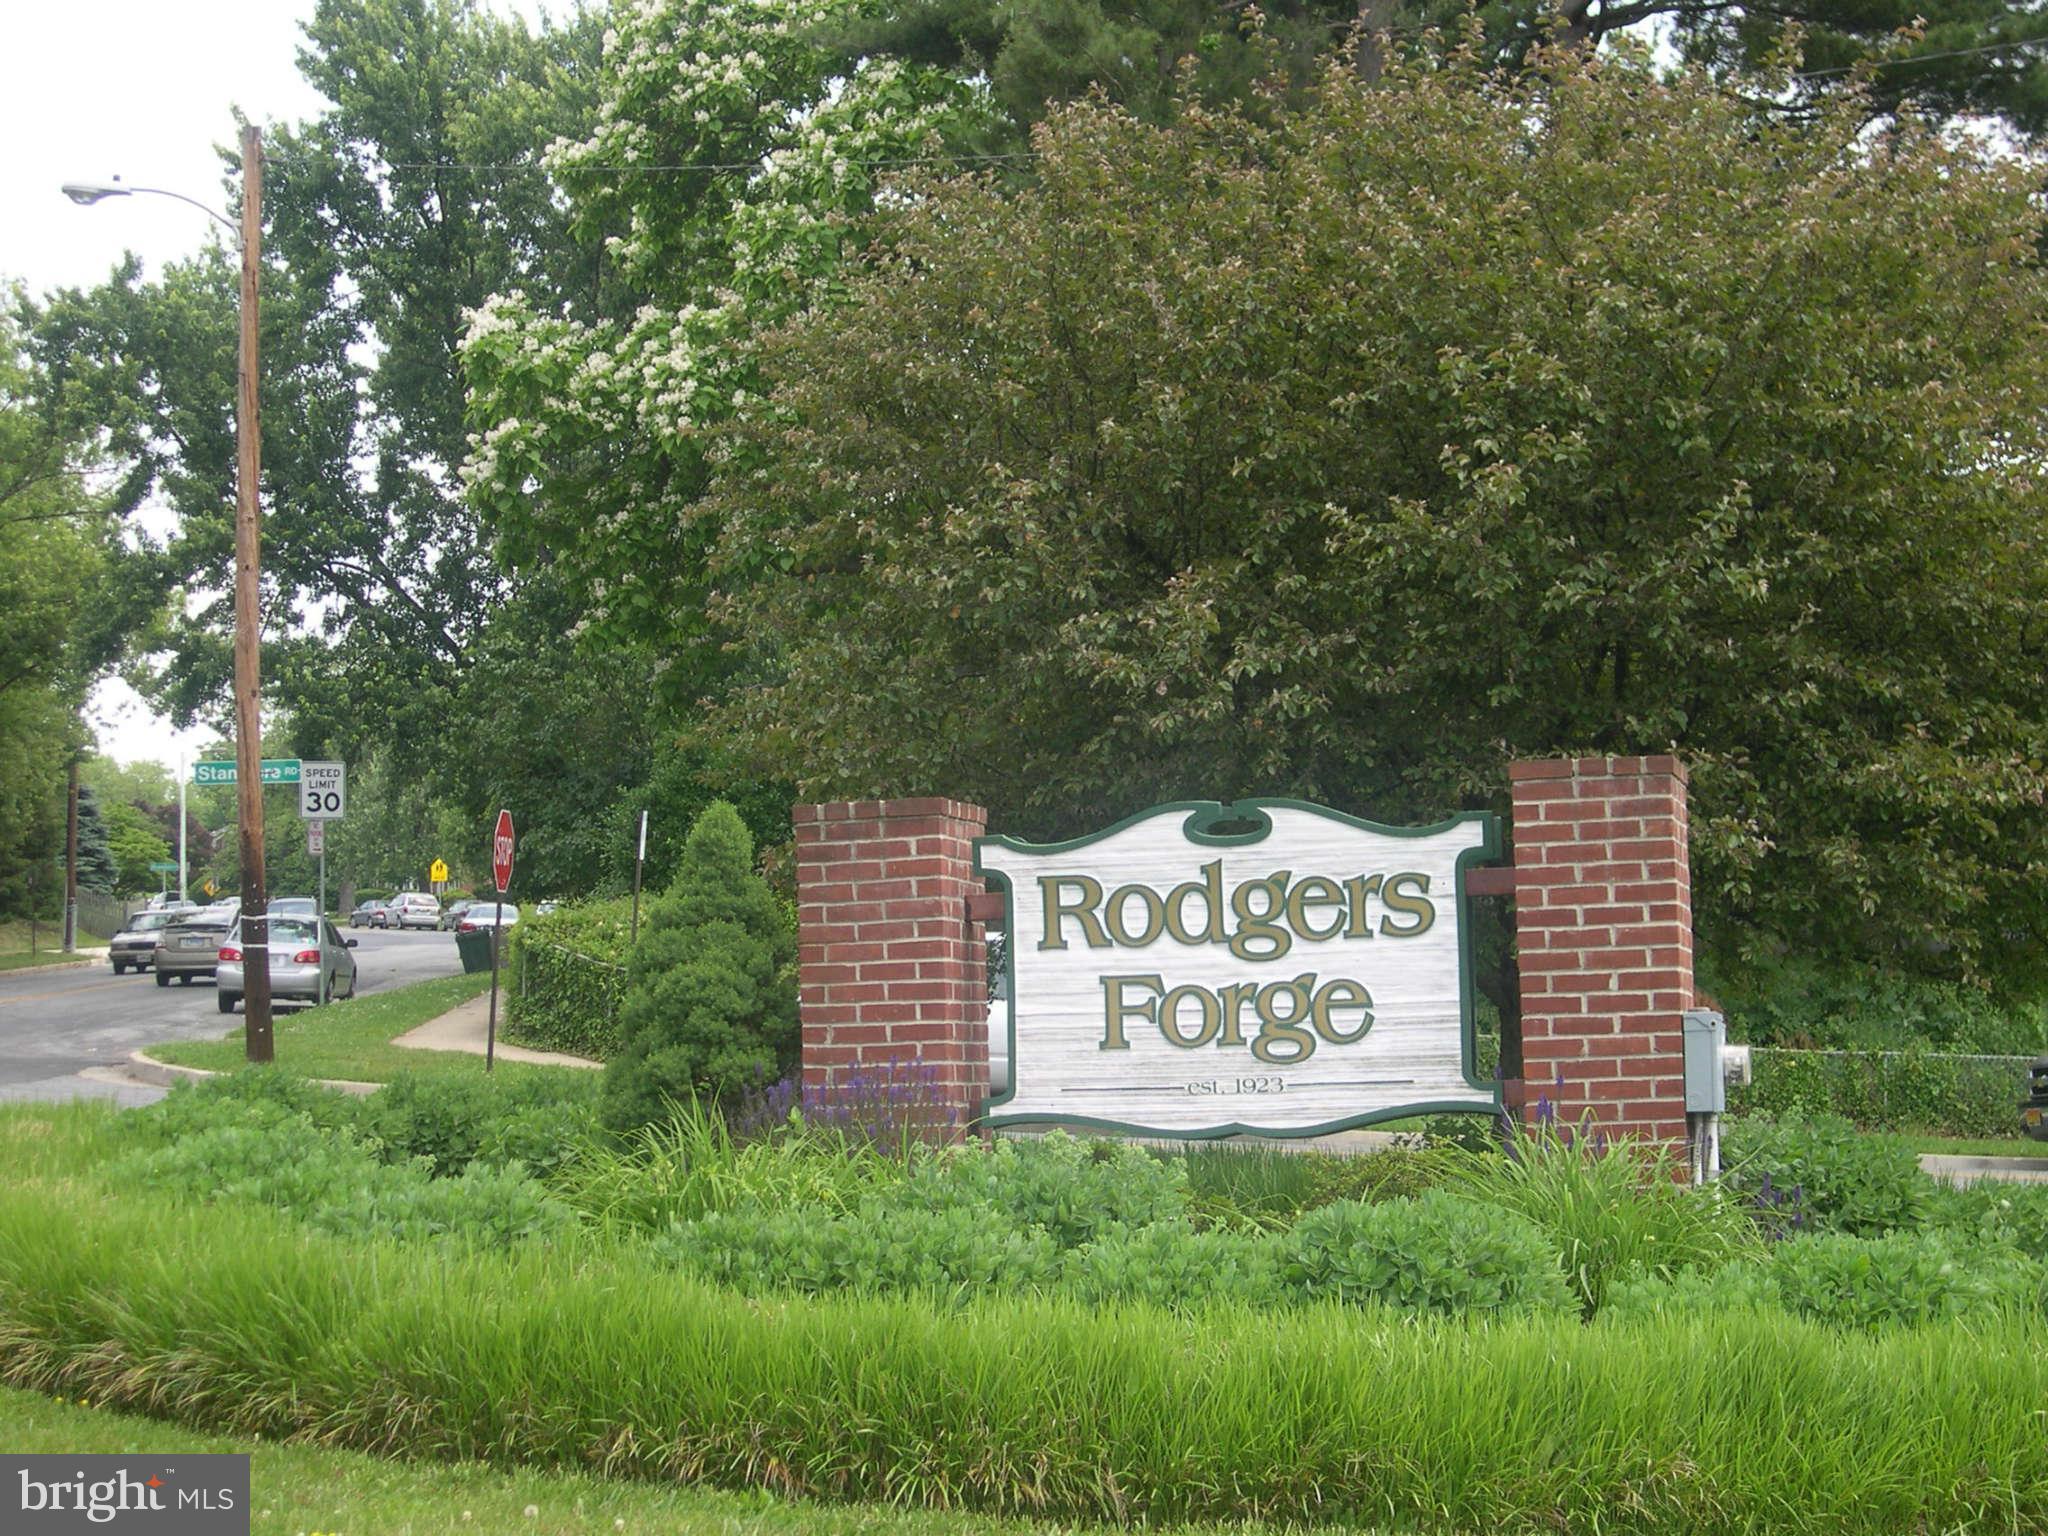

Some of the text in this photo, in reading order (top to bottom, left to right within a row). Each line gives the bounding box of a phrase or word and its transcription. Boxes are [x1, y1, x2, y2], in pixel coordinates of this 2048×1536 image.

[305, 768, 341, 778] SPEED
[309, 780, 336, 790] LIMIT
[306, 792, 340, 812] 30
[496, 835, 512, 866] STOP
[1037, 859, 1436, 961] Rodgers
[1099, 973, 1375, 1064] Forge
[1187, 1077, 1284, 1096] est. 1923
